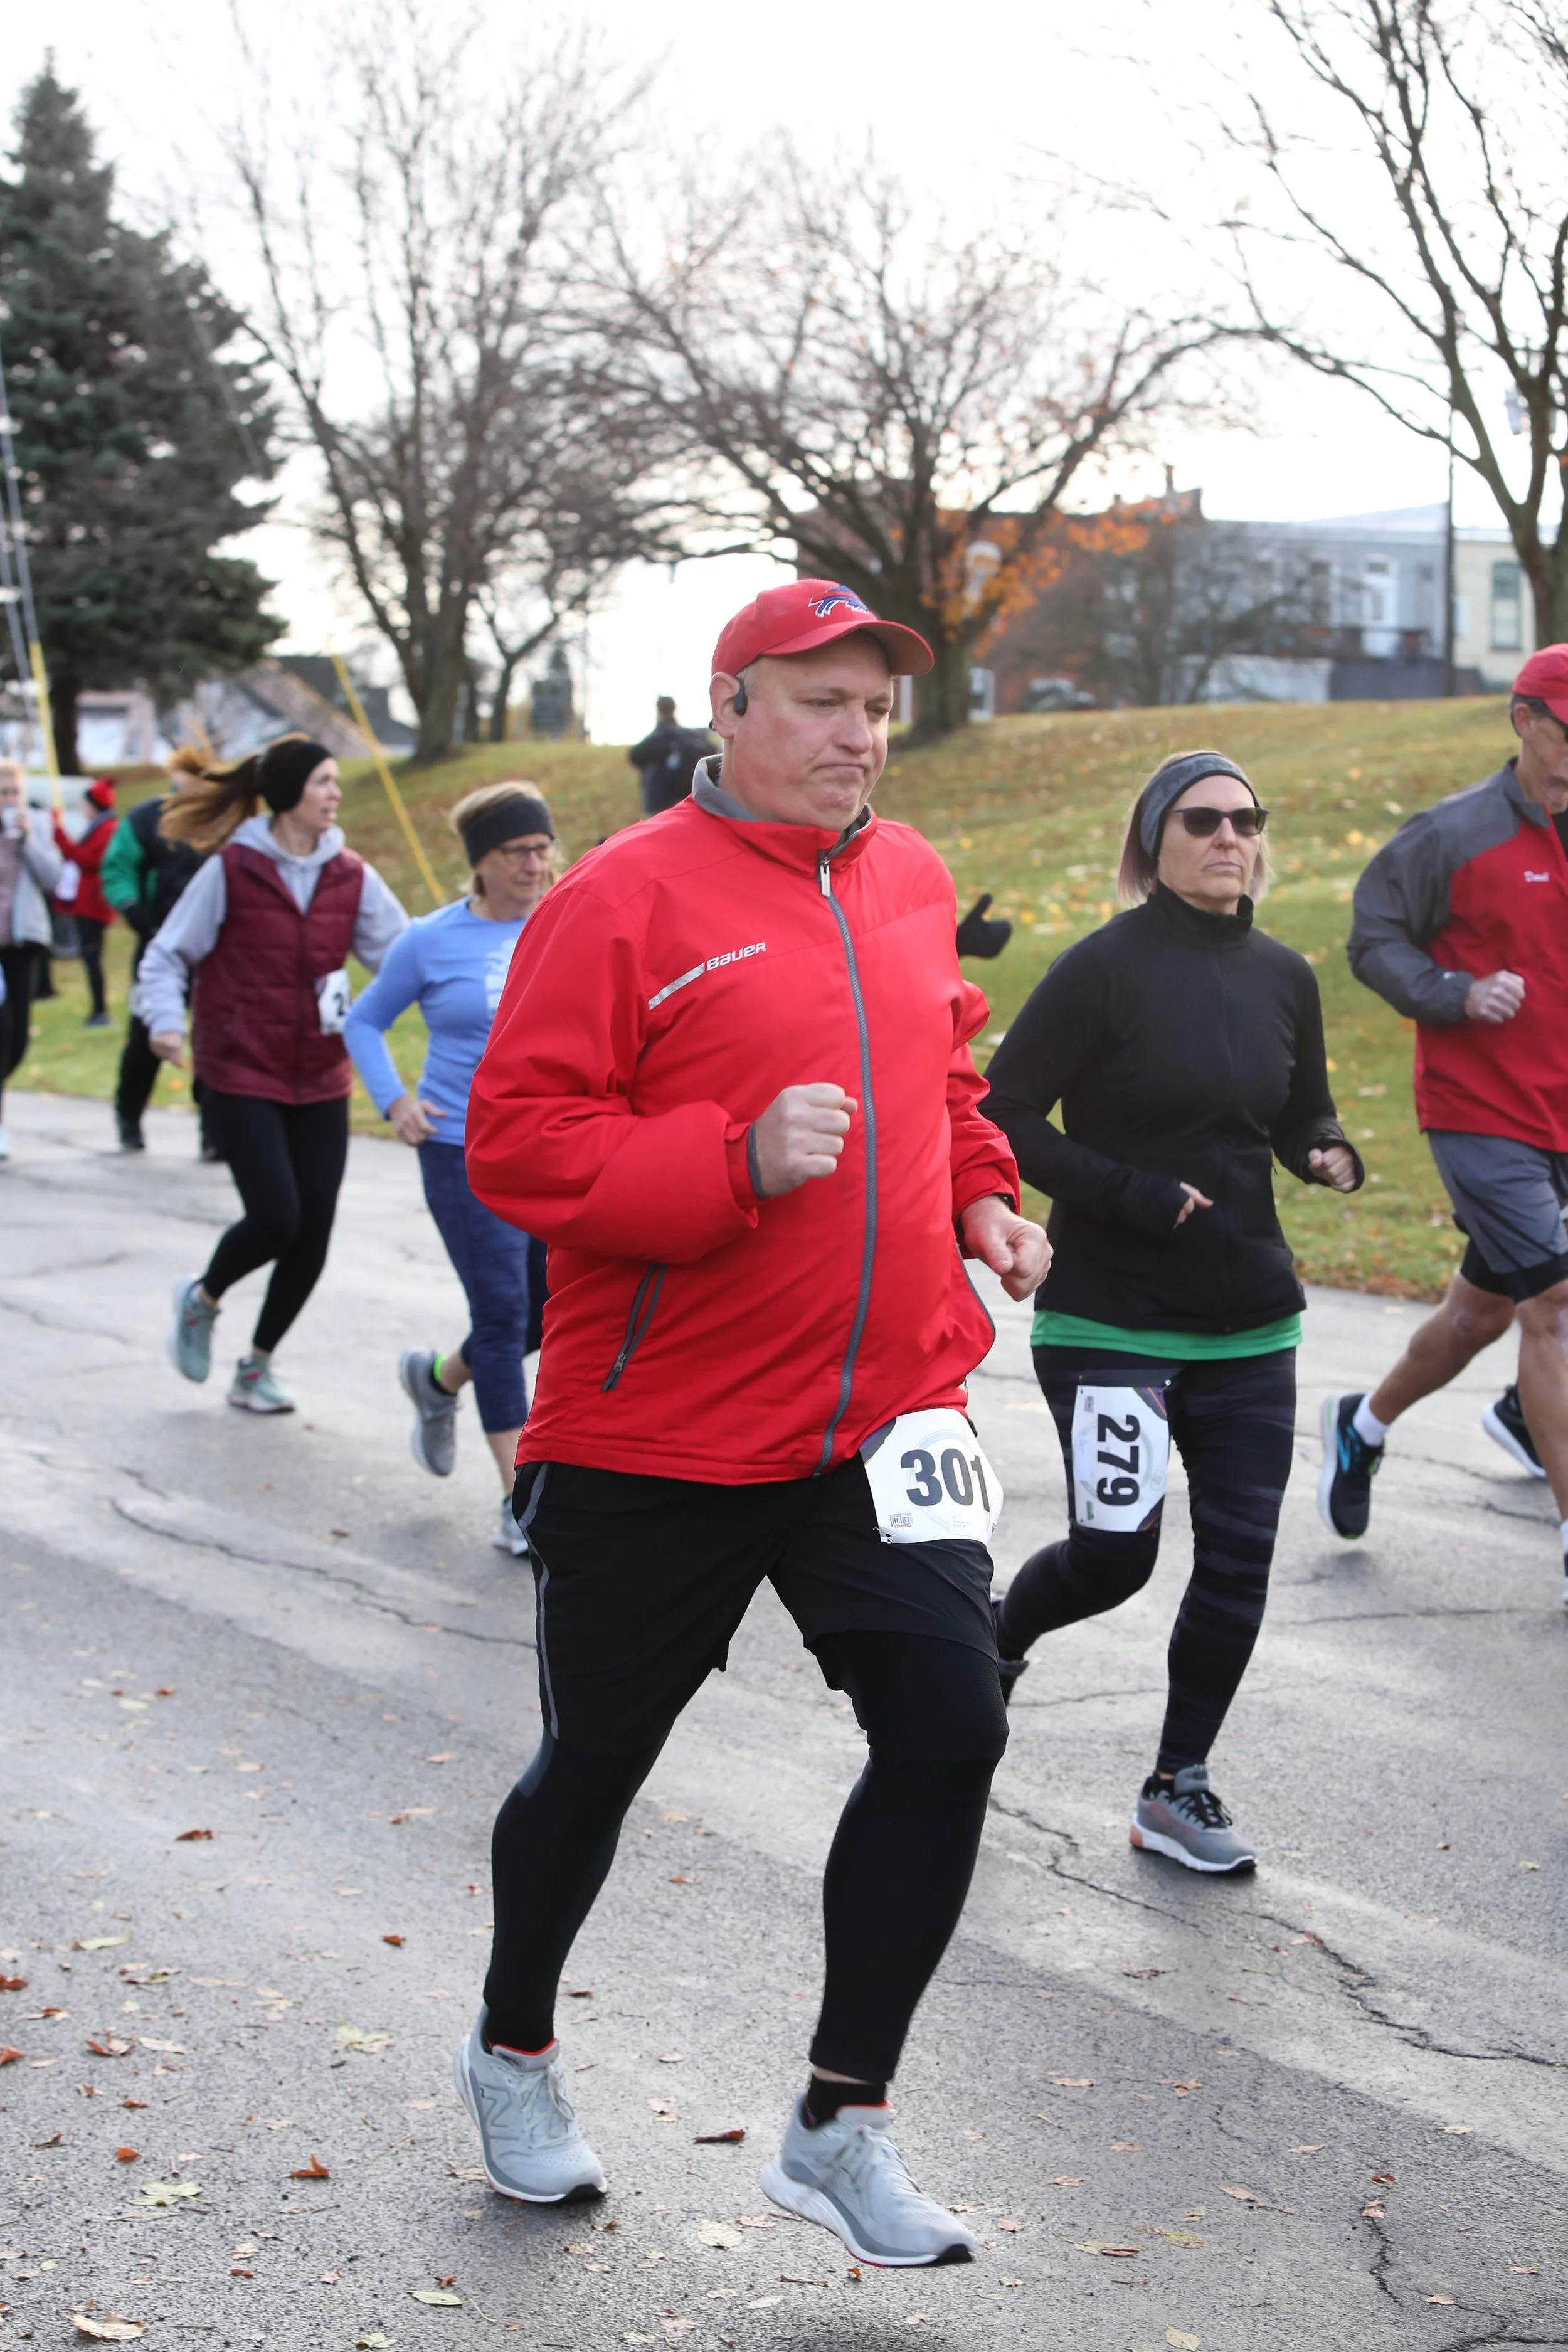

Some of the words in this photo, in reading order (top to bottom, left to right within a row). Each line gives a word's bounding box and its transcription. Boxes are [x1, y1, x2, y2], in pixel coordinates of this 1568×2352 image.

[333, 992, 349, 1016] 2
[900, 1448, 990, 1513] 301
[1097, 1413, 1140, 1506] 279
